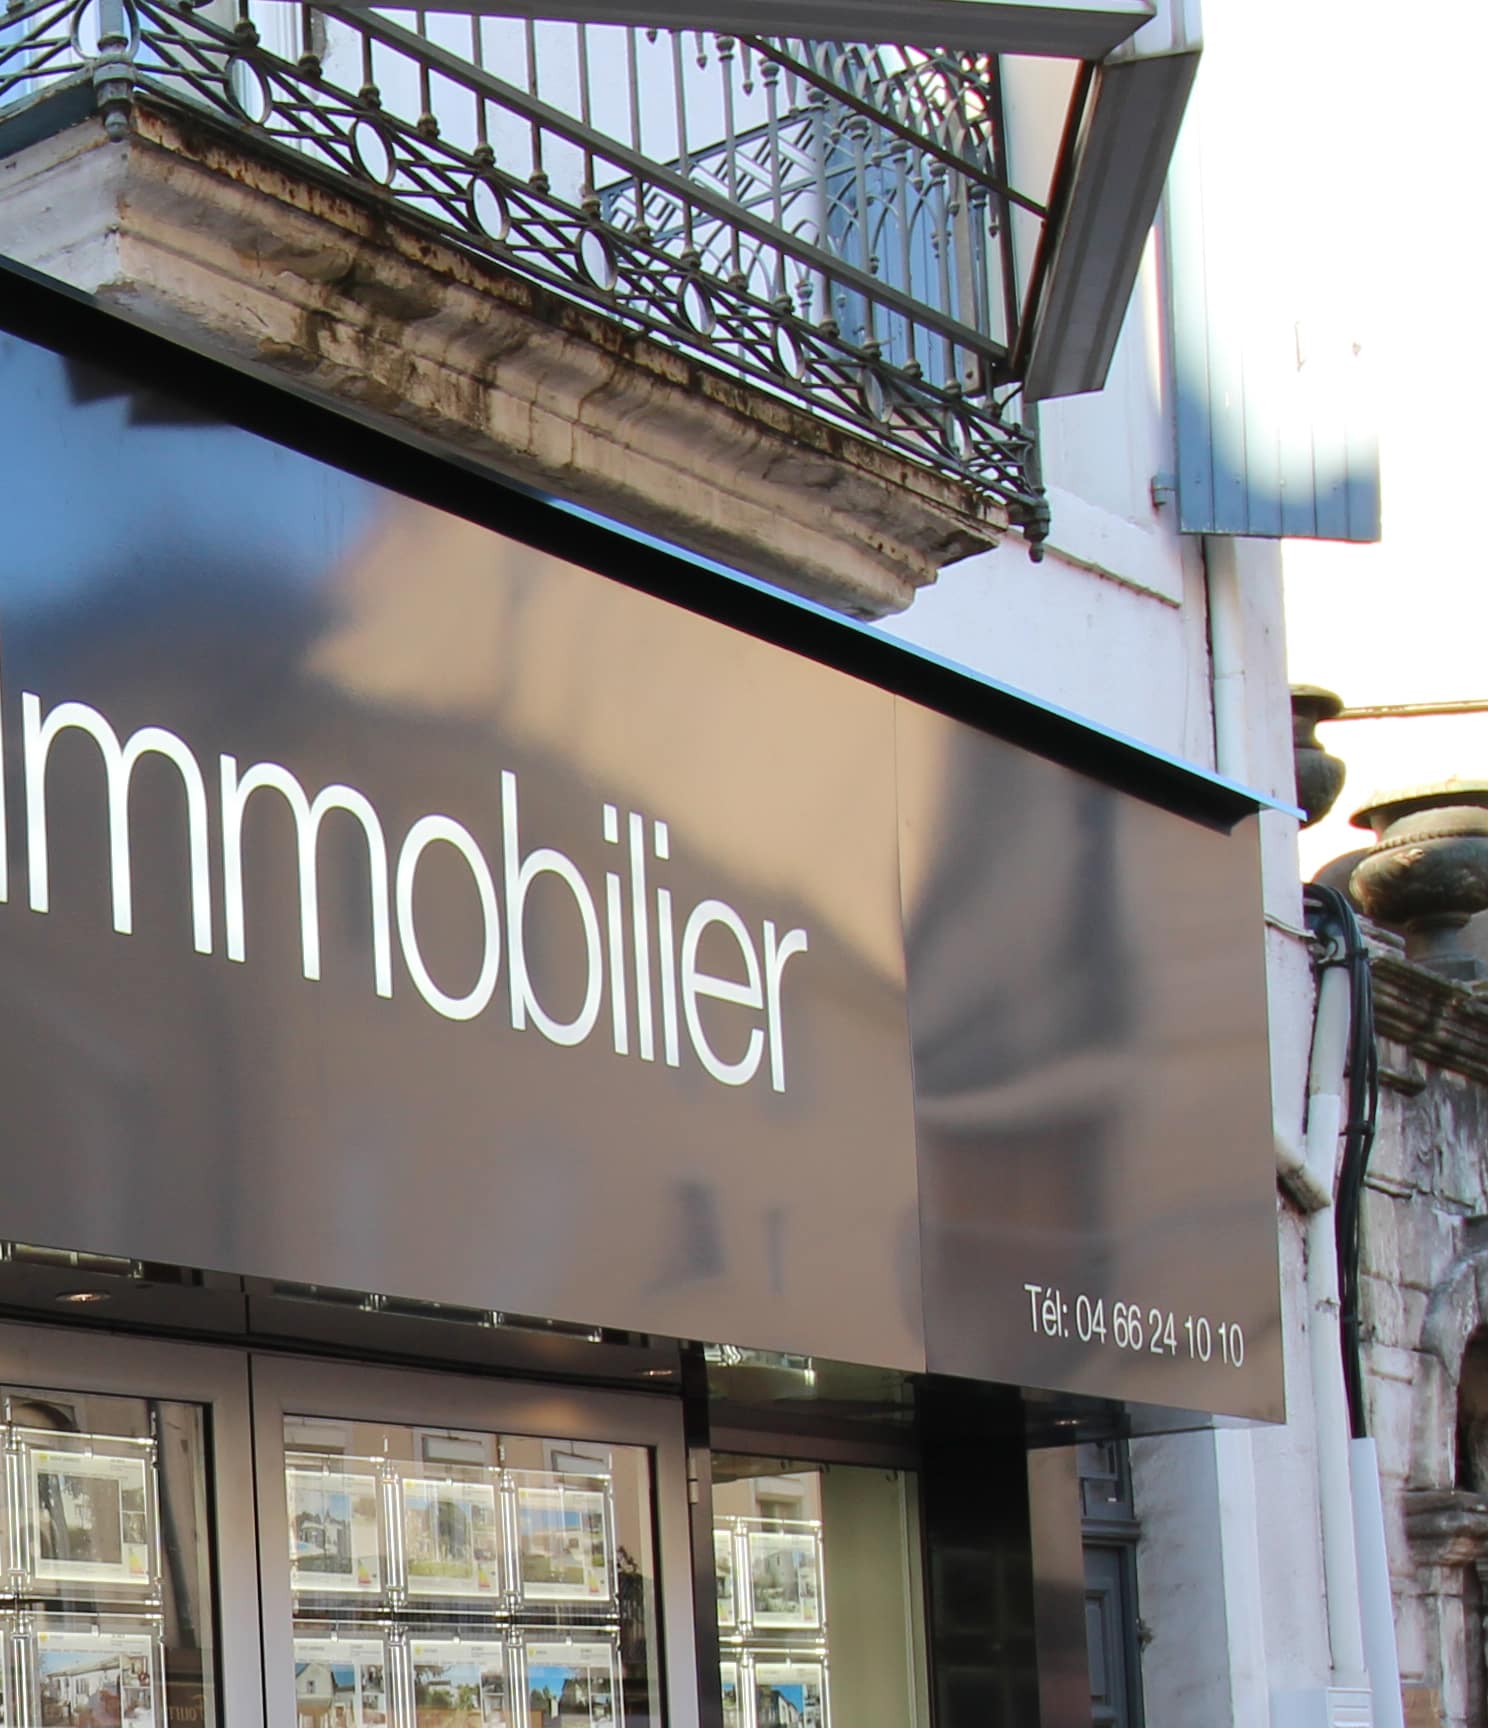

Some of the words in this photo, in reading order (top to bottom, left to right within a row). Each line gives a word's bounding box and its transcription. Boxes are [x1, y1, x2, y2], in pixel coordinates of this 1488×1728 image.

[1024, 1283, 1069, 1338] Tél:
[1076, 1294, 1107, 1345] 04
[1113, 1302, 1143, 1351] 66
[1148, 1308, 1178, 1356] 24
[1184, 1315, 1212, 1362] 10
[1218, 1321, 1245, 1368] 10
